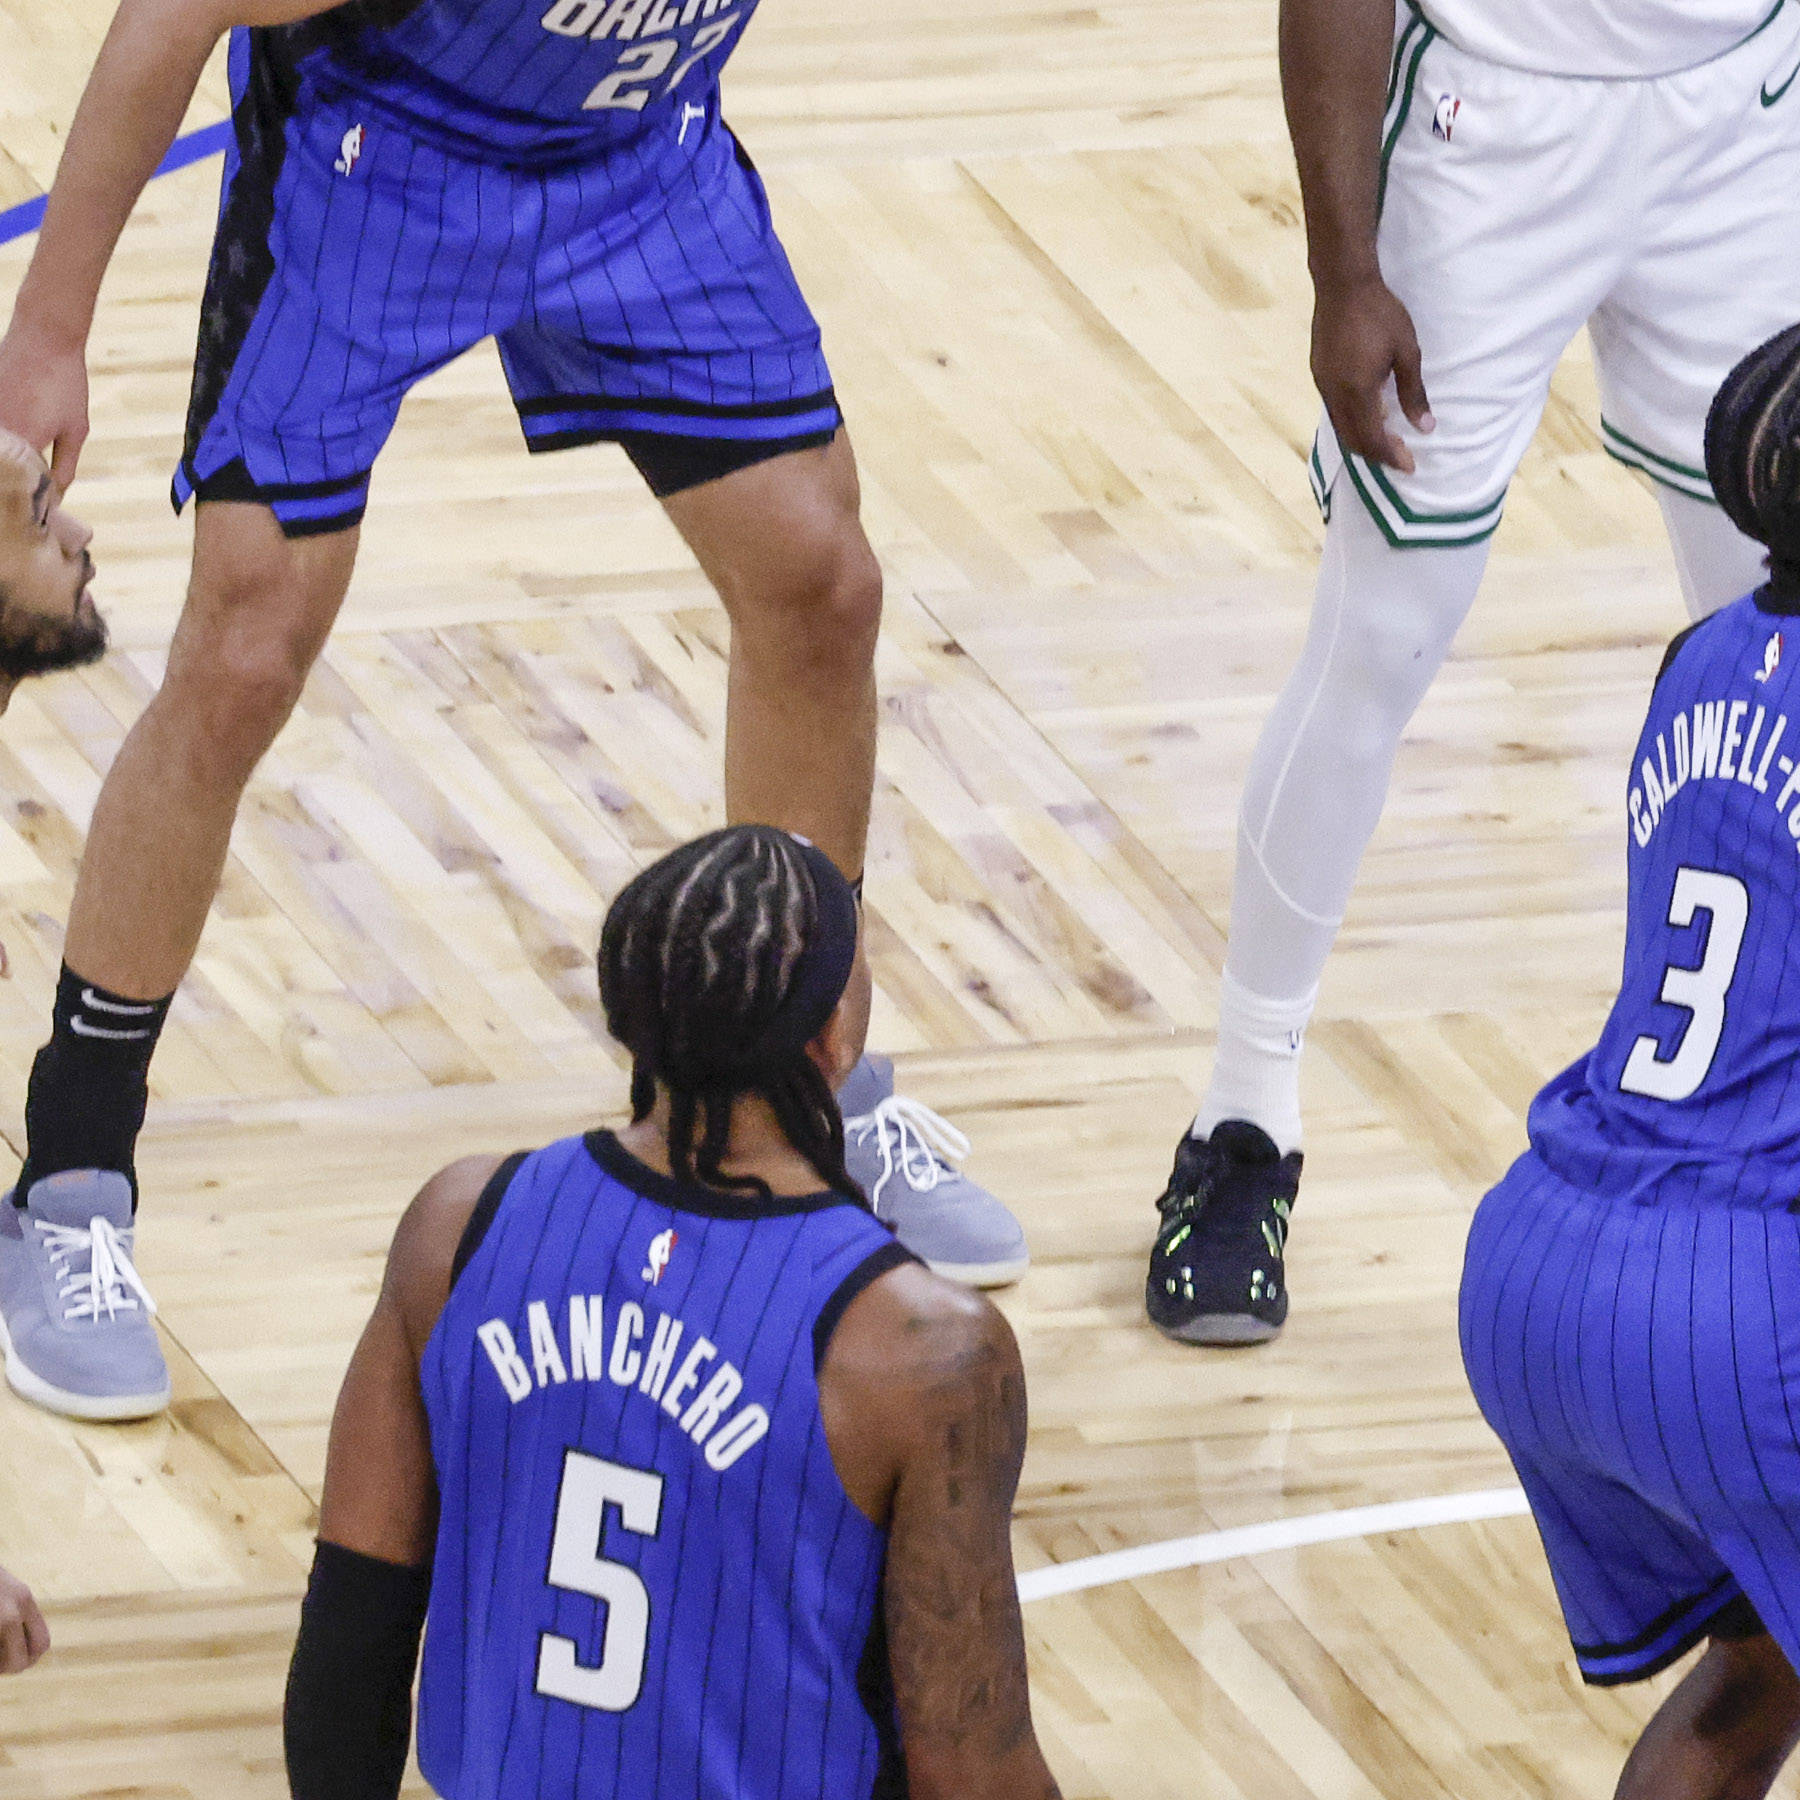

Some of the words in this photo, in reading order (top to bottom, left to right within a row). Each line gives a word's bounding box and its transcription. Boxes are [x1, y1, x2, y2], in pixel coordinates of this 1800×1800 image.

[1619, 866, 1751, 1103] 3
[477, 1294, 770, 1473] BANCHERO
[534, 1449, 663, 1713] 5
